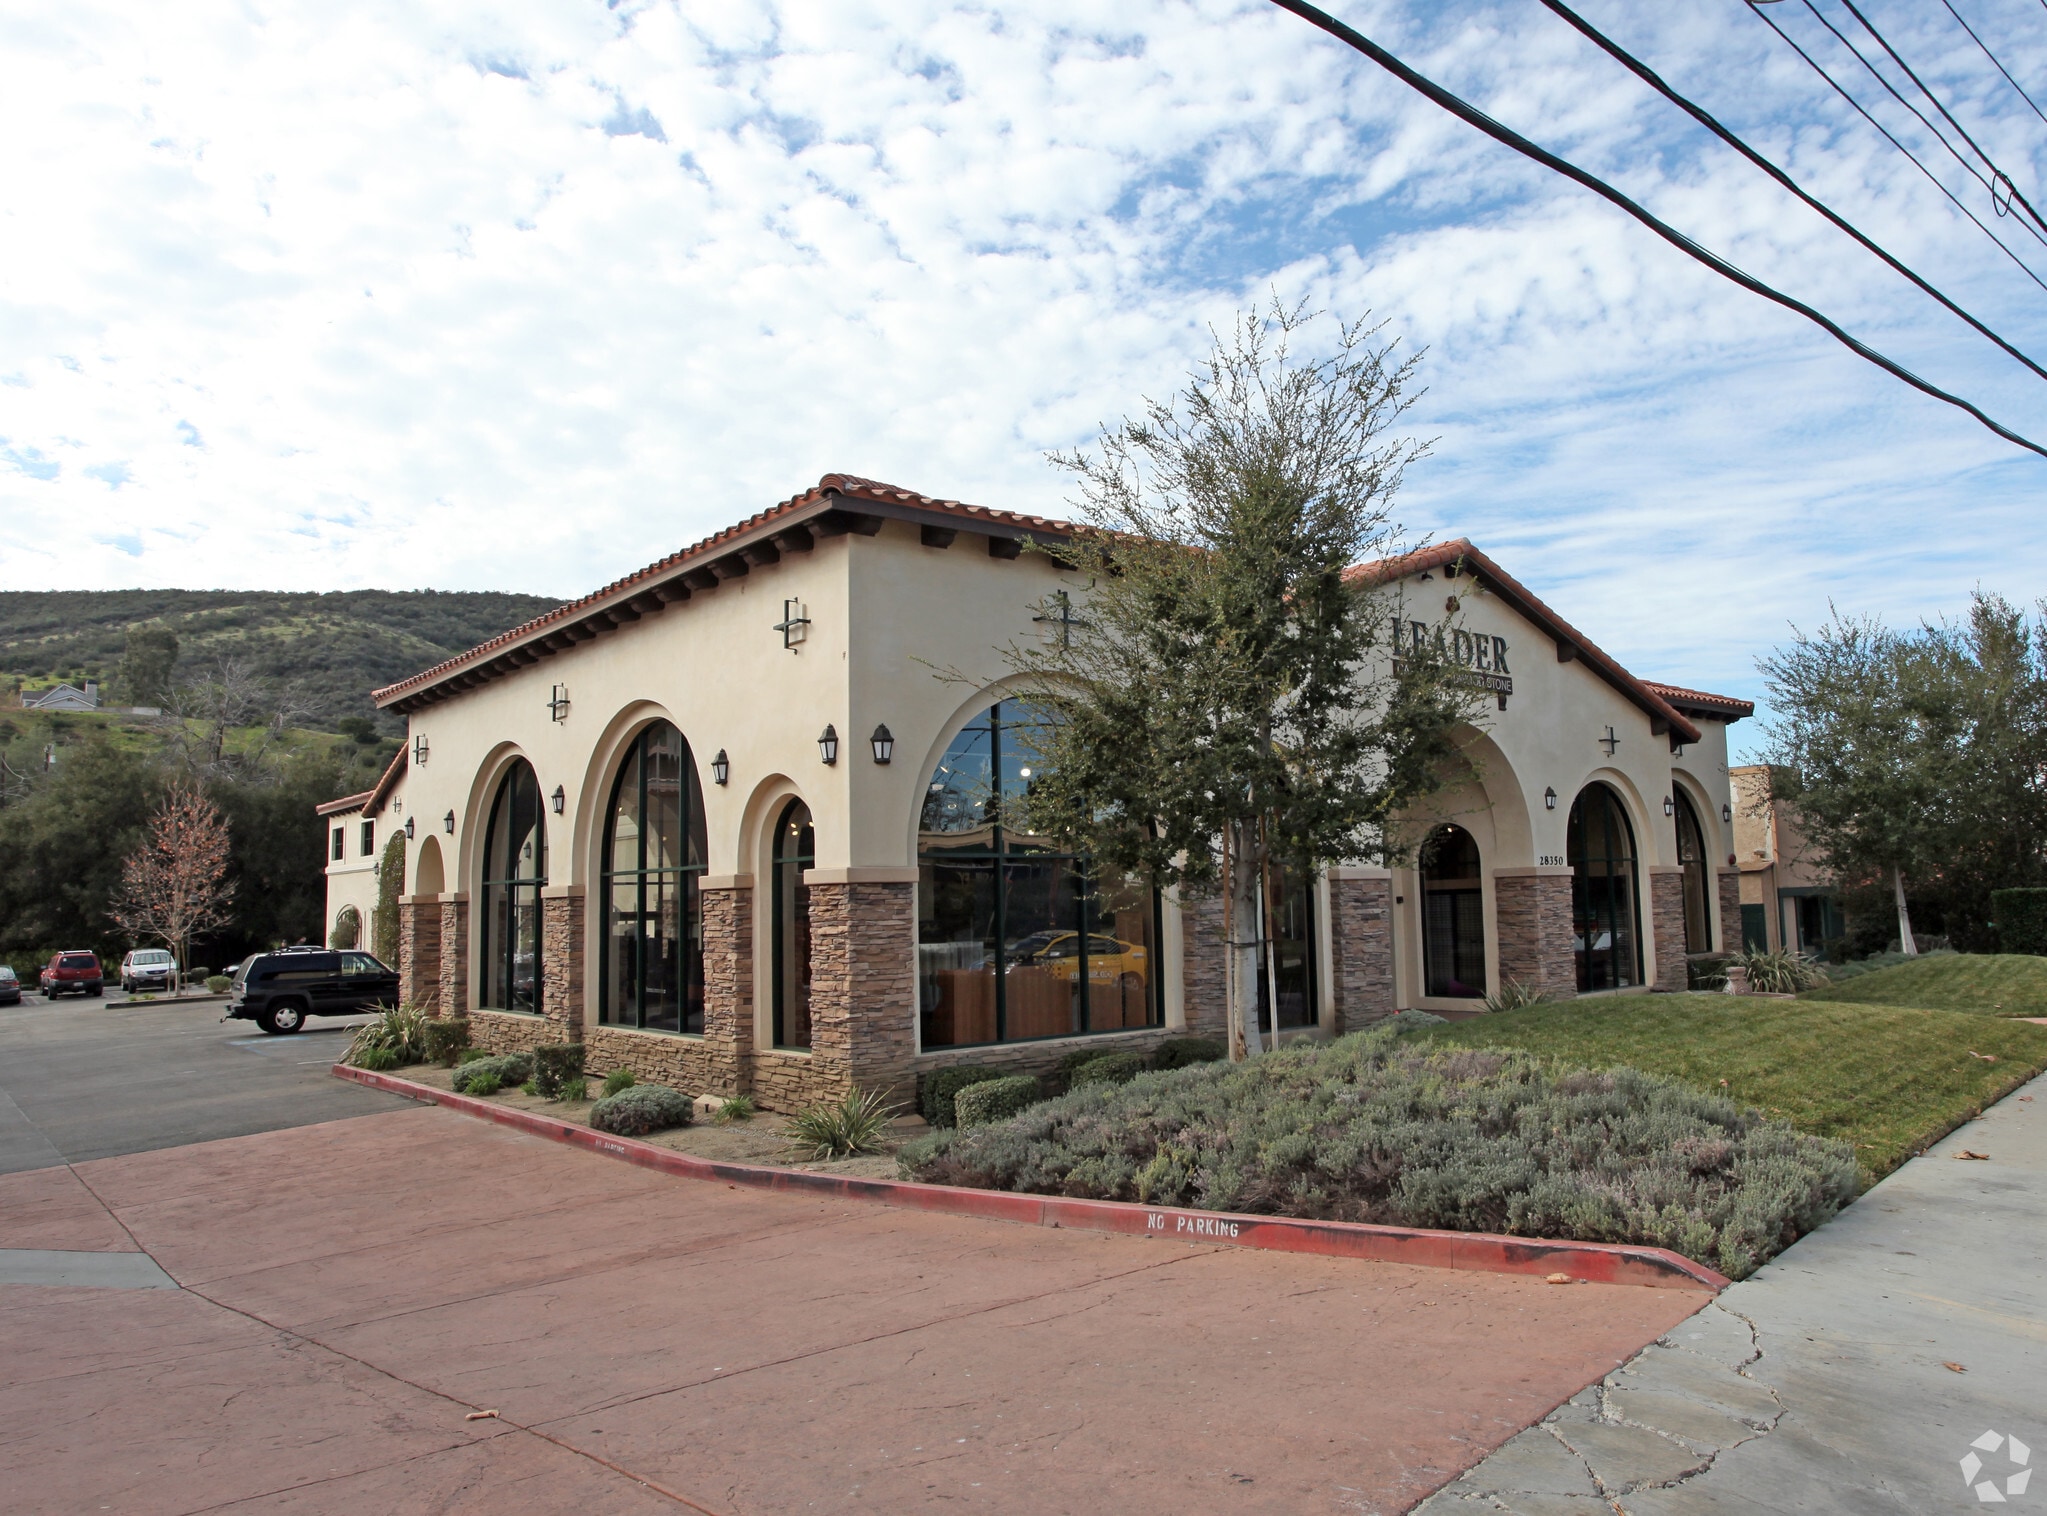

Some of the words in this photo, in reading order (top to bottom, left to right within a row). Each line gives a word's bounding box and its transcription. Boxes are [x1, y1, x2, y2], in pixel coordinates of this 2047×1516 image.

[1486, 677, 1512, 692] STONE
[1539, 855, 1564, 866] 28350
[1147, 1213, 1165, 1230] NO
[1177, 1216, 1239, 1238] PARKING
